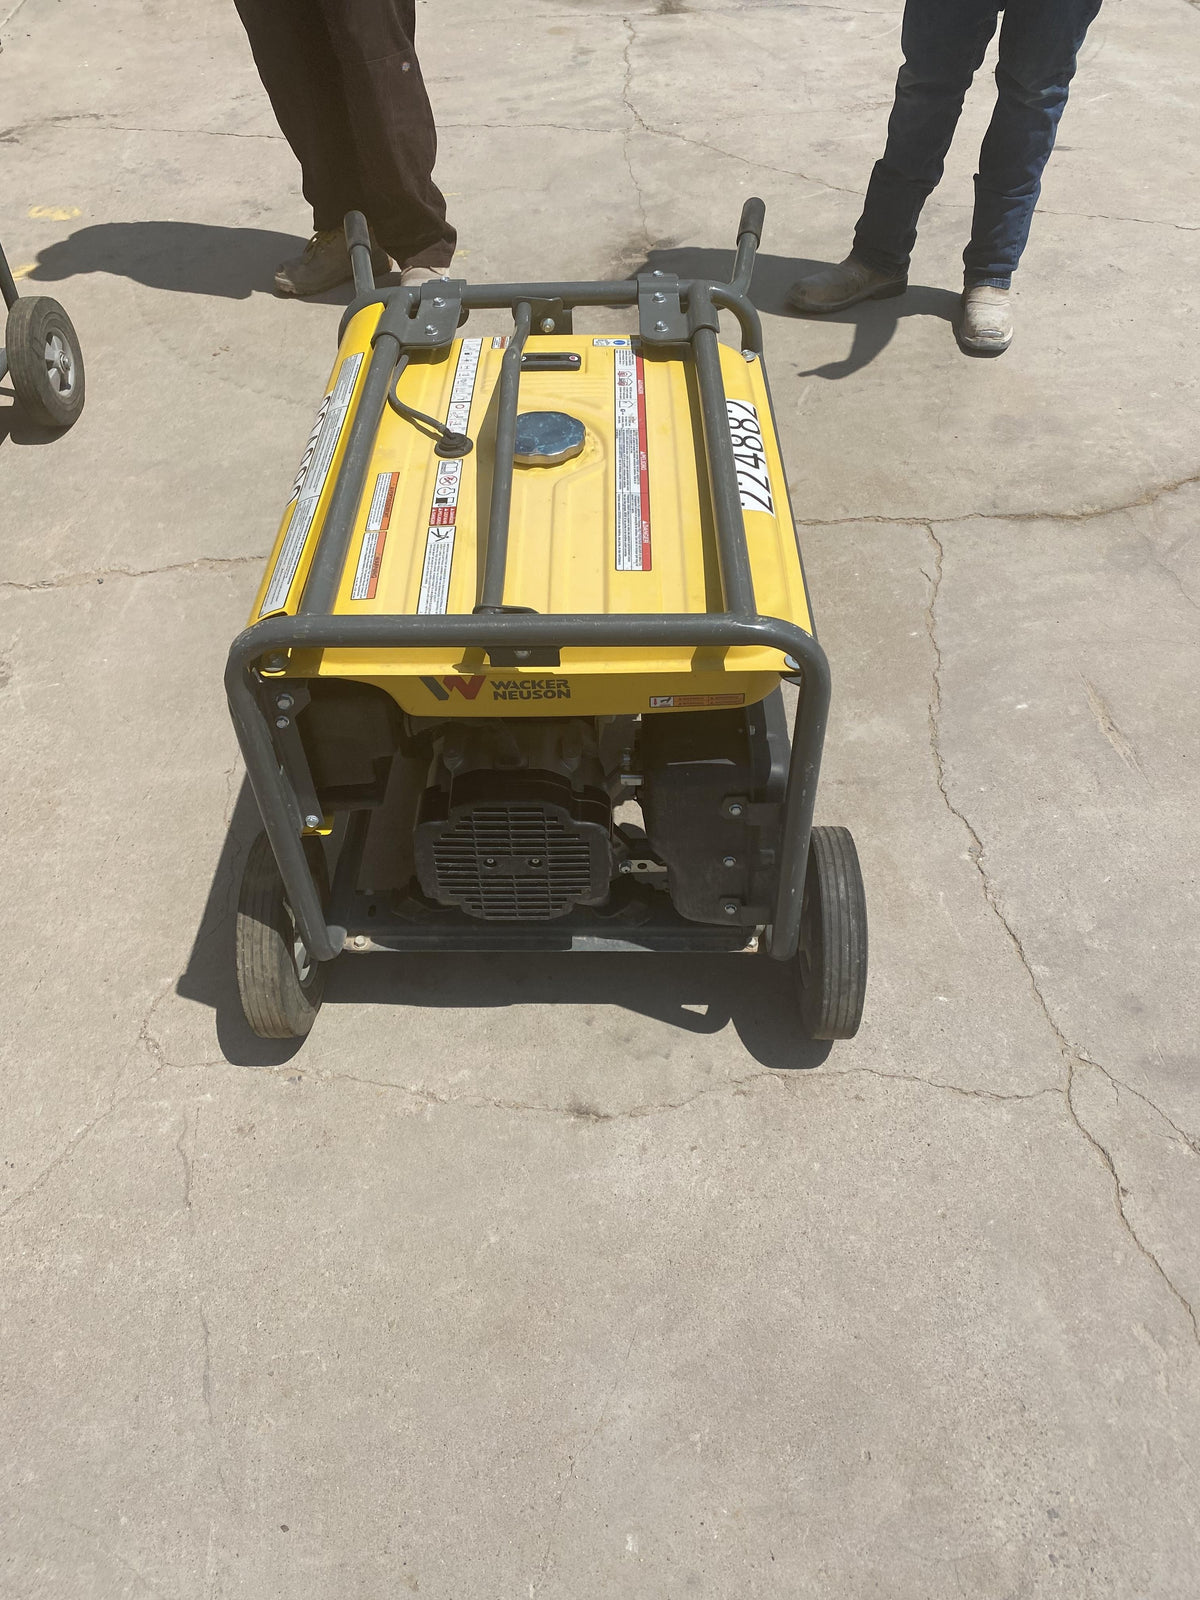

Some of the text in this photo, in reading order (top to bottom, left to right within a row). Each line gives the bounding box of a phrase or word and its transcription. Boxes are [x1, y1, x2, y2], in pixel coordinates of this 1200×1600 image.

[642, 525, 650, 544] DANGER
[490, 679, 570, 690] WACKER
[493, 689, 571, 700] NEUSON
